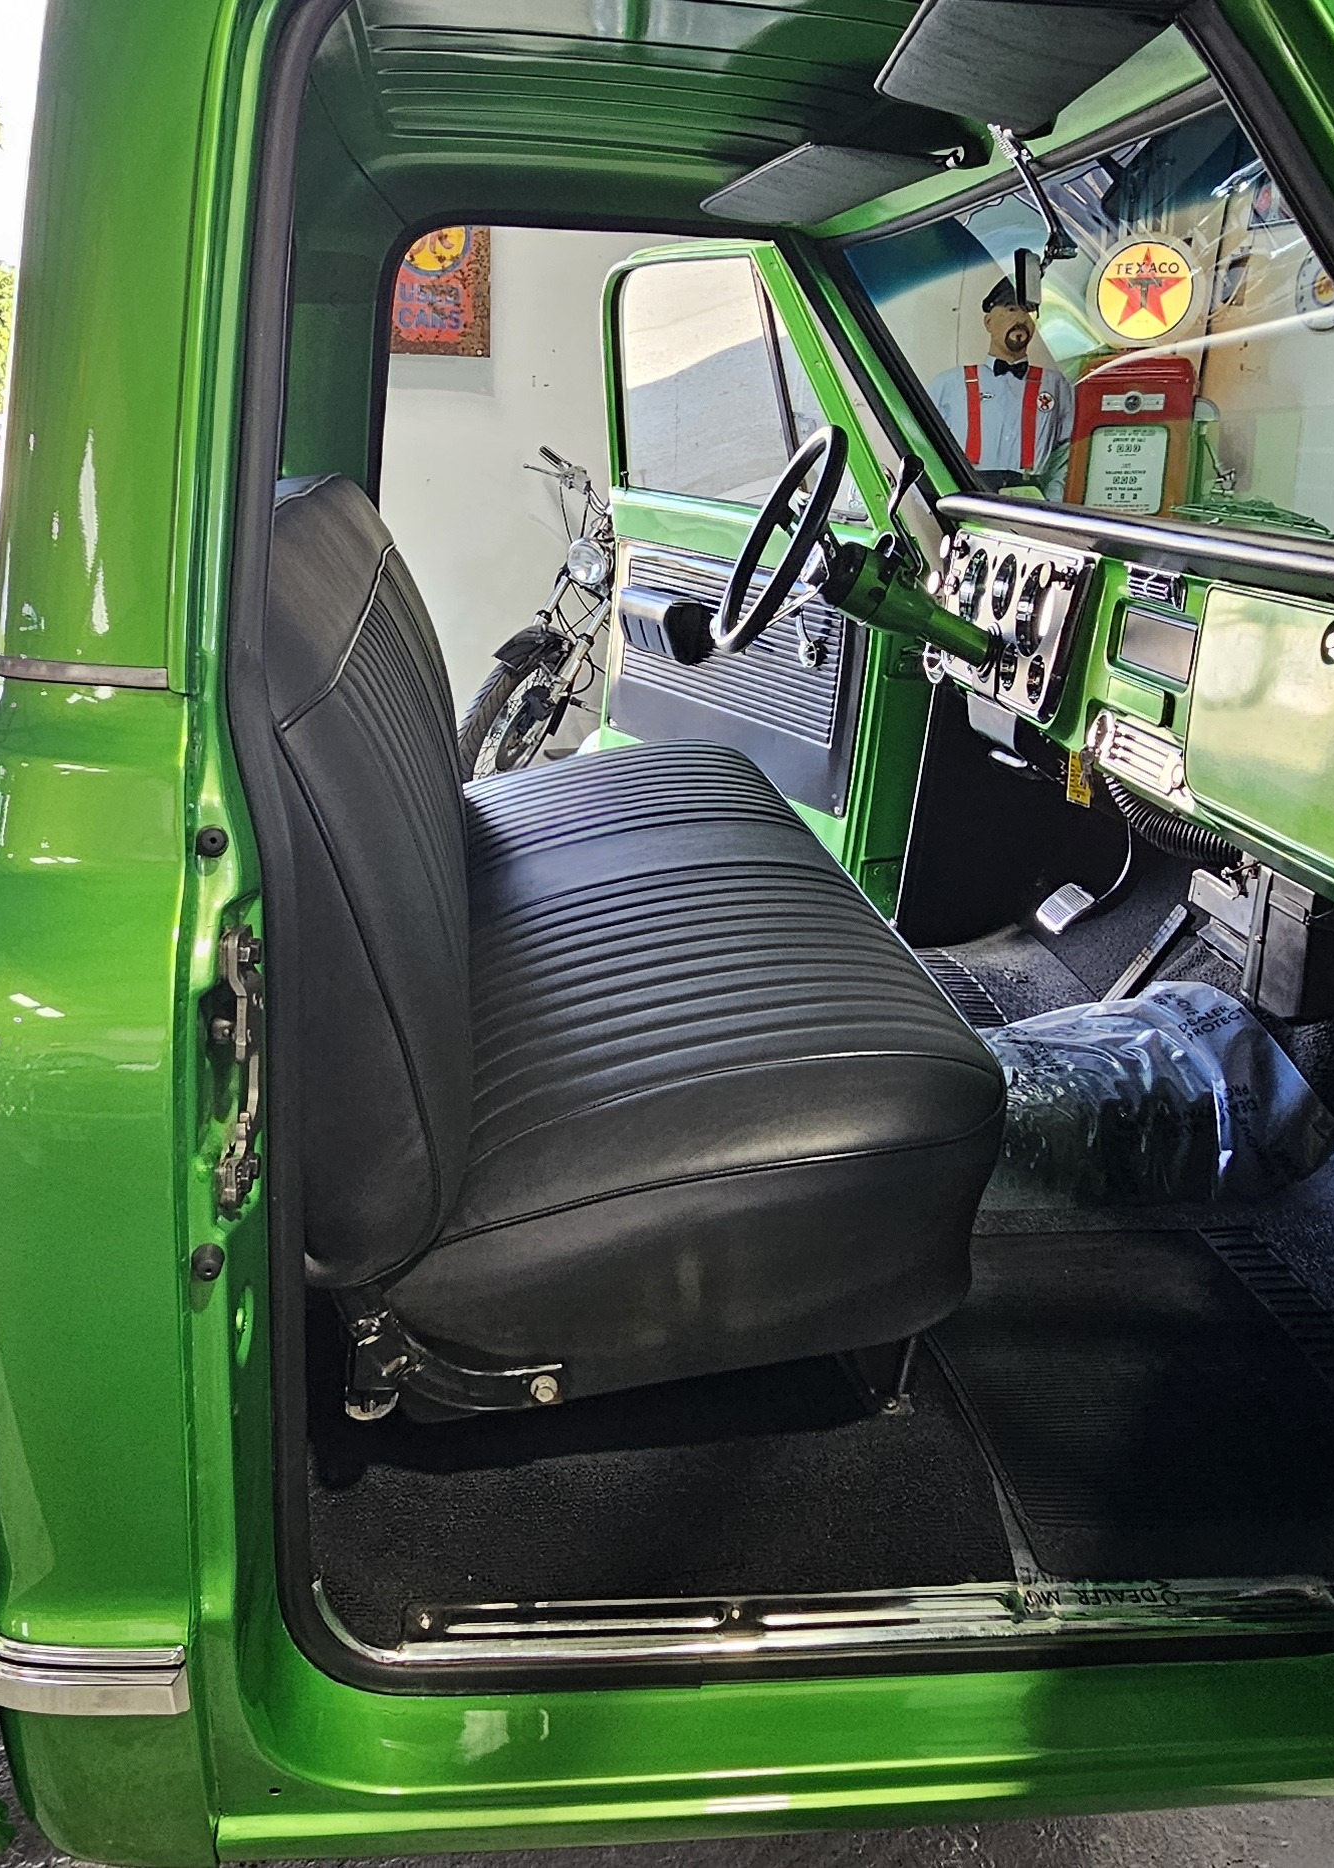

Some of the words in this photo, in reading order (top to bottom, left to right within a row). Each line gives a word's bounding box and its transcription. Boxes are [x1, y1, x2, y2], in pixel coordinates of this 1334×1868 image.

[1114, 261, 1180, 275] TEXACO
[399, 282, 461, 306] USED
[398, 307, 463, 329] CARS
[1178, 1004, 1230, 1034] DEALER
[1186, 1006, 1248, 1042] PROTECT
[1075, 1588, 1157, 1605] DEALER
